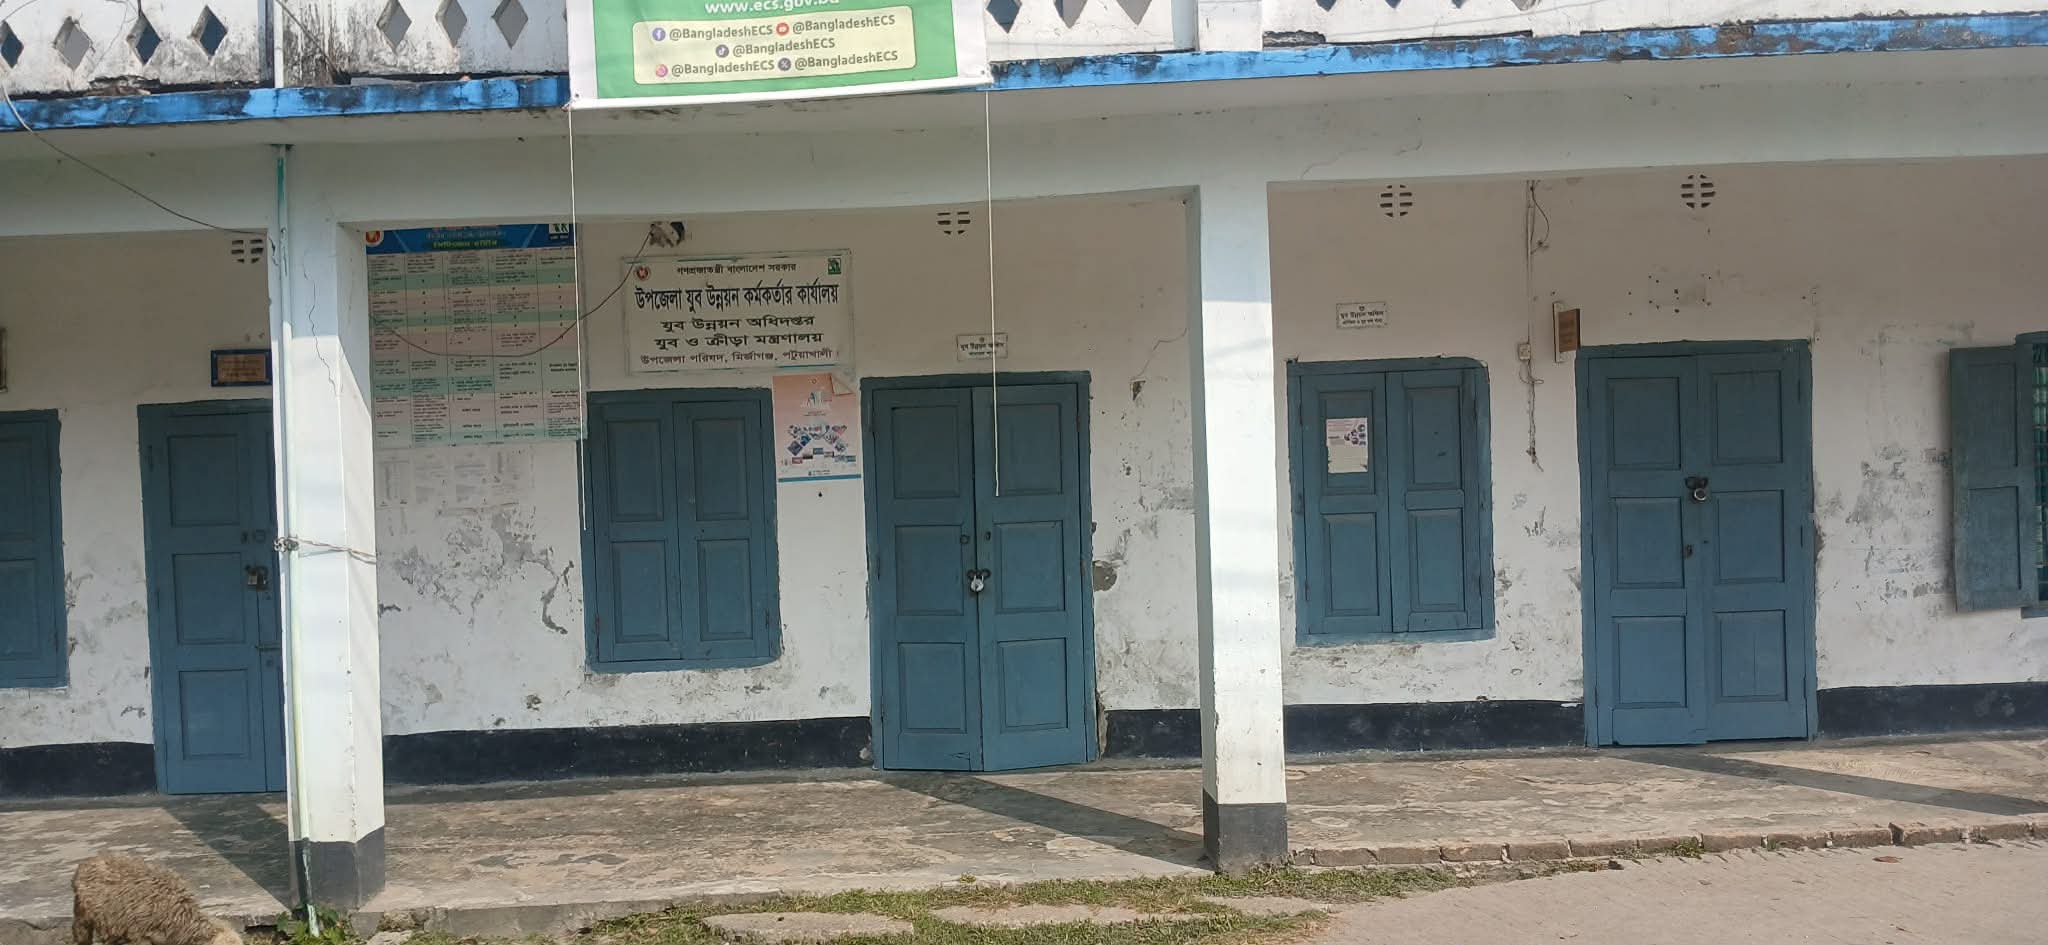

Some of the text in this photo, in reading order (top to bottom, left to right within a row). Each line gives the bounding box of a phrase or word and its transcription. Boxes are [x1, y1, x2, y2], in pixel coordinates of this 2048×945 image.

[669, 14, 896, 40] @BangladeshECS @BangladeshECS
[732, 37, 836, 57] @BangladeshECS
[671, 50, 898, 77] @BangladeshECS @BangladeshECS
[677, 263, 797, 275] গণপ্রজাতন্ত্রী বাংলাদেশ সরকার
[634, 277, 839, 314] উপজেলা যুব উন্নয়ন কর্মকর্তার কার্যালয়
[660, 314, 815, 333] যুব উন্নয়ন অধিদপ্তর
[654, 333, 824, 351] যুব ও ক্রীড়া মন্ত্রণালয়
[640, 354, 686, 366] উপজেলা
[690, 352, 729, 364] পরিষদ,
[782, 348, 833, 361] পটুয়াখালী
